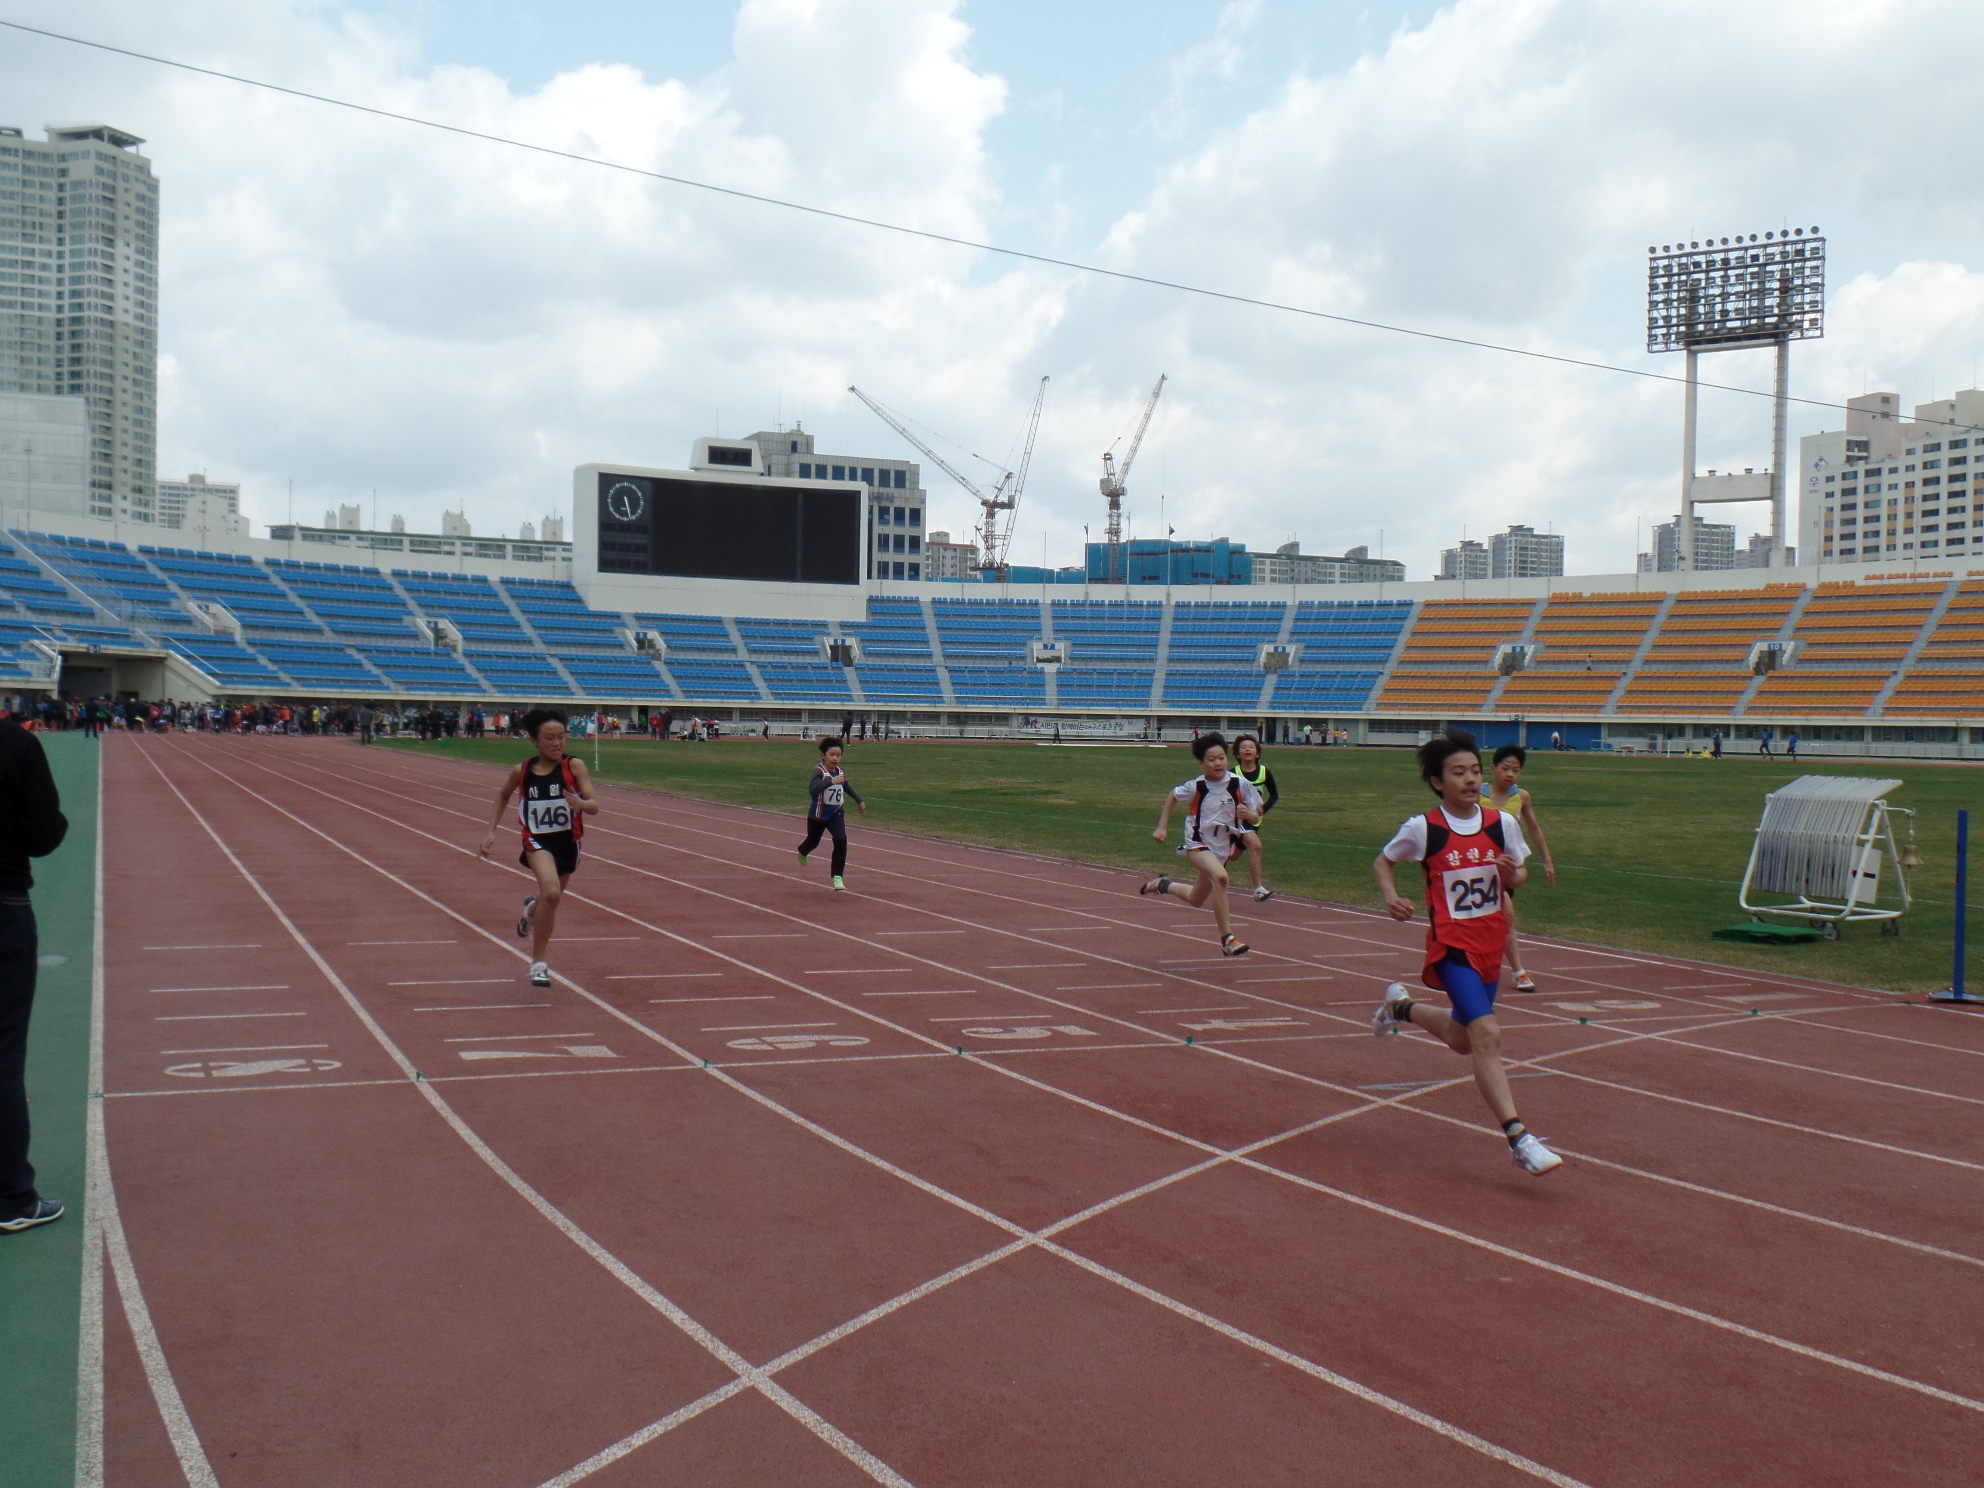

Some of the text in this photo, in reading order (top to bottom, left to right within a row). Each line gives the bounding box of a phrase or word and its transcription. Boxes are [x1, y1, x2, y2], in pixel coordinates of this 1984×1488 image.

[828, 788, 842, 803] 76
[530, 805, 570, 829] 146
[1450, 874, 1500, 912] 254
[961, 1025, 1101, 1040] 5
[726, 1034, 872, 1050] 6
[458, 1045, 625, 1061] 7
[163, 1058, 343, 1078] 8
